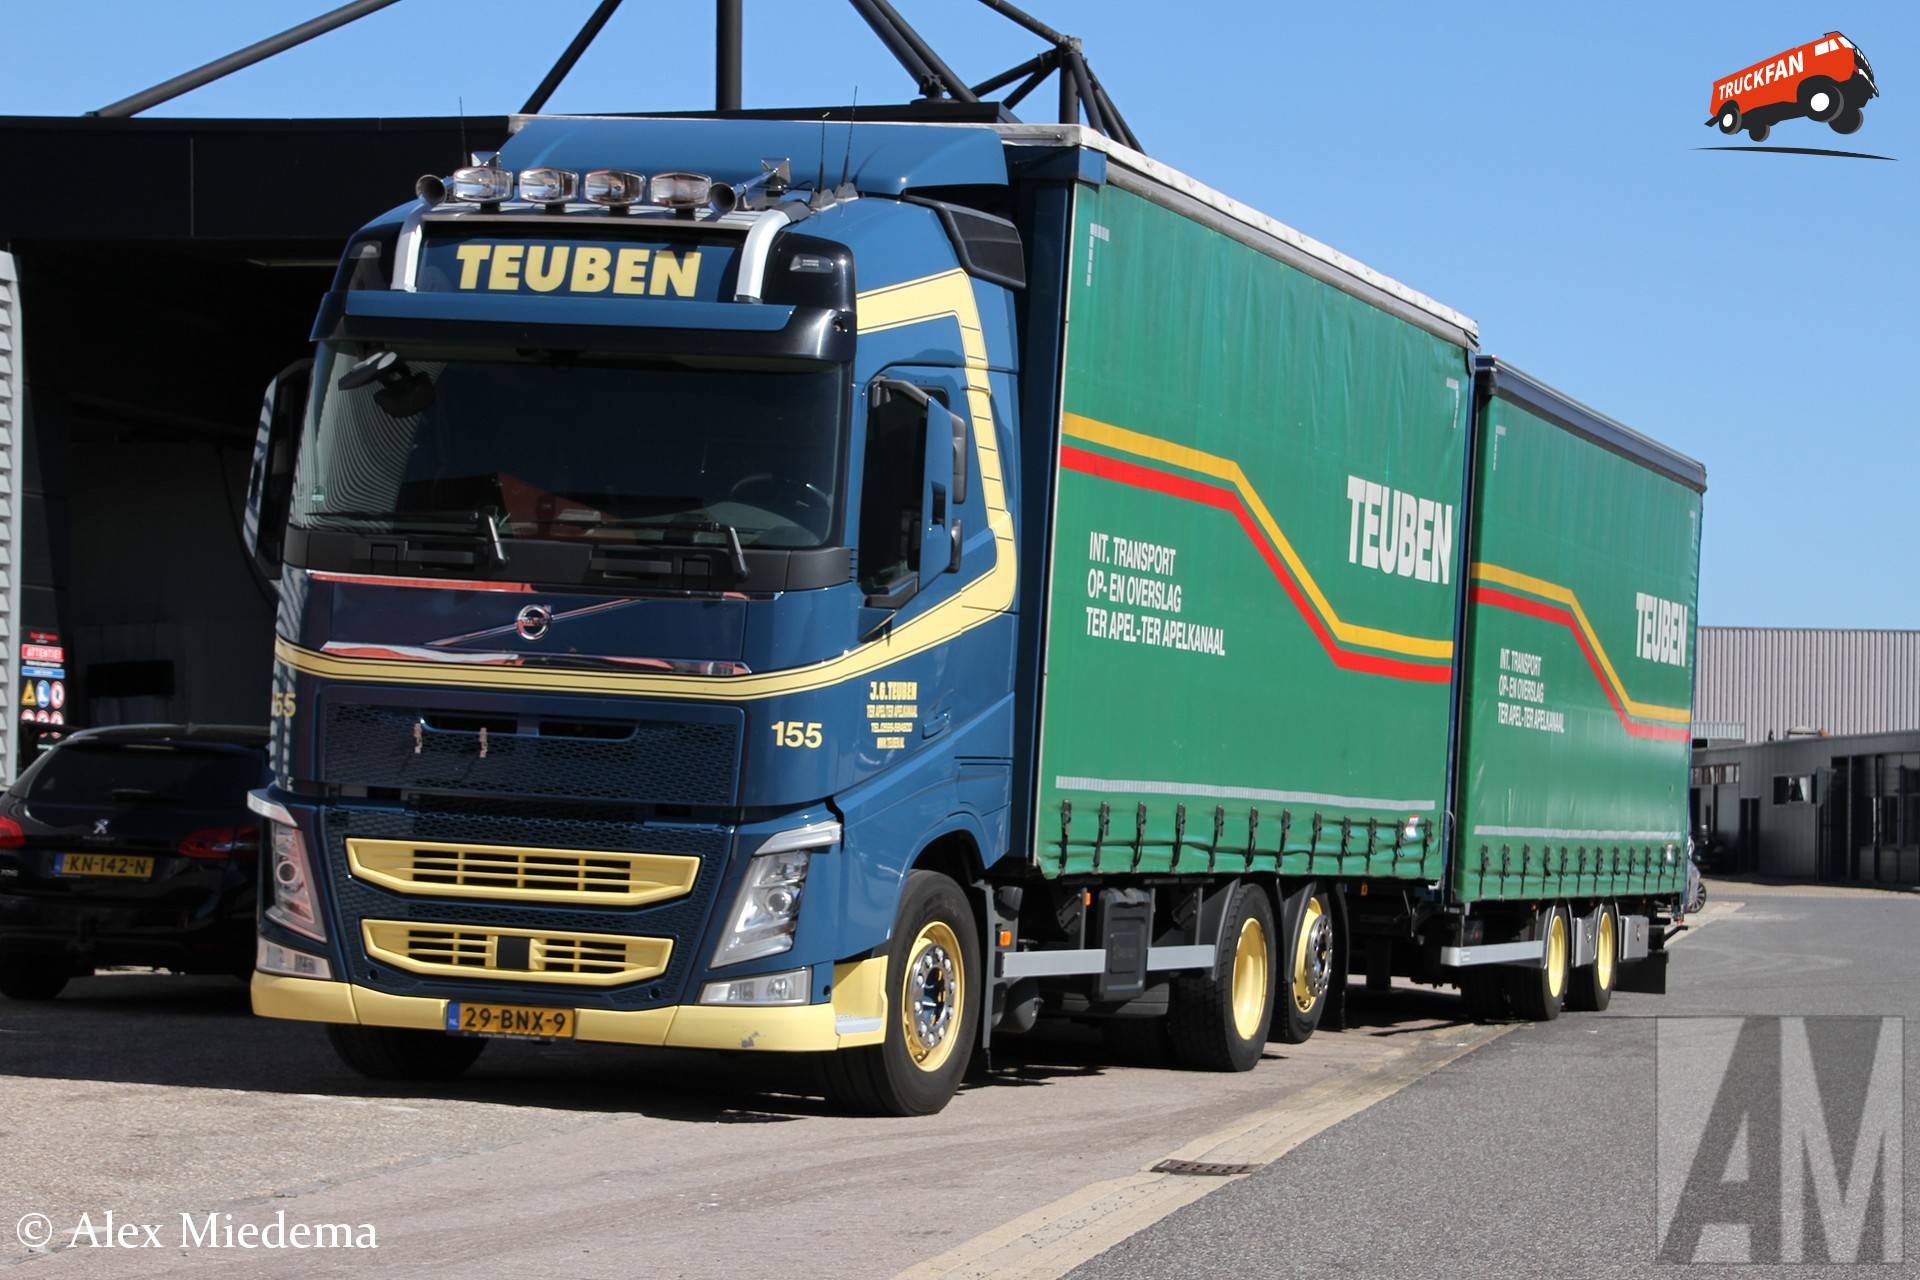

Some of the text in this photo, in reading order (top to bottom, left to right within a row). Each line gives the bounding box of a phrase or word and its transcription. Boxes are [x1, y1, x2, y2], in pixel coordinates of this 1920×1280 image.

[456, 244, 702, 297] TEUBEN
[1347, 475, 1453, 584] TEUBEN
[1089, 531, 1176, 576] INT. TRANSPORT
[1109, 573, 1125, 603] EN
[1127, 576, 1182, 613] OVERSLAG
[1086, 607, 1107, 638] TER
[1162, 619, 1225, 656] APELKANAAL
[1635, 592, 1688, 667] TEUBEN
[1511, 650, 1542, 677] TRANSPORT
[772, 720, 823, 749] 155
[69, 855, 148, 875] KN-142-N
[465, 1007, 566, 1033] 29-BNX-9
